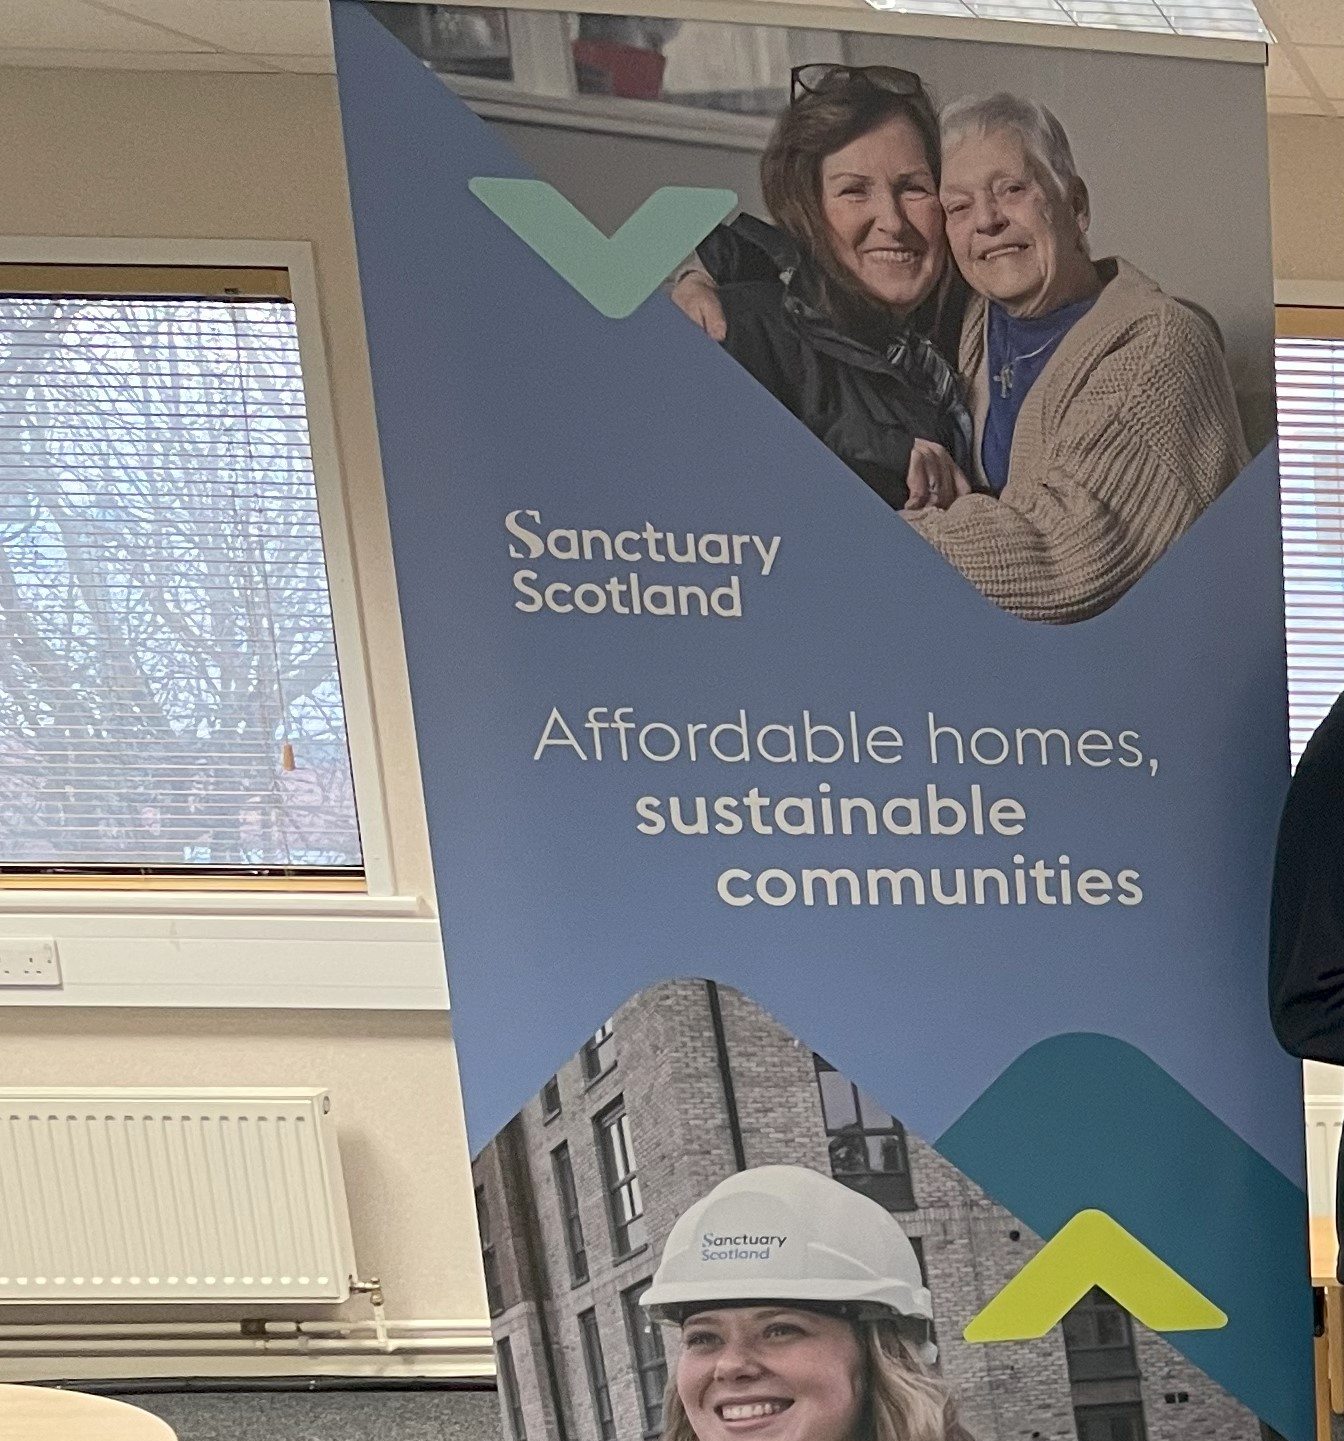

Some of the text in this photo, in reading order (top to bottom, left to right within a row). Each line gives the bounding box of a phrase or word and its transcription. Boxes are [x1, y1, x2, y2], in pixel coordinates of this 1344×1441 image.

[504, 509, 781, 575] Sanctuary
[513, 569, 742, 617] Scotland
[533, 706, 1160, 777] Affordable homes,
[635, 782, 1027, 836] sustainable
[716, 853, 1145, 907] communities
[702, 1233, 787, 1248] Sanctuary
[702, 1247, 770, 1262] Scotland
